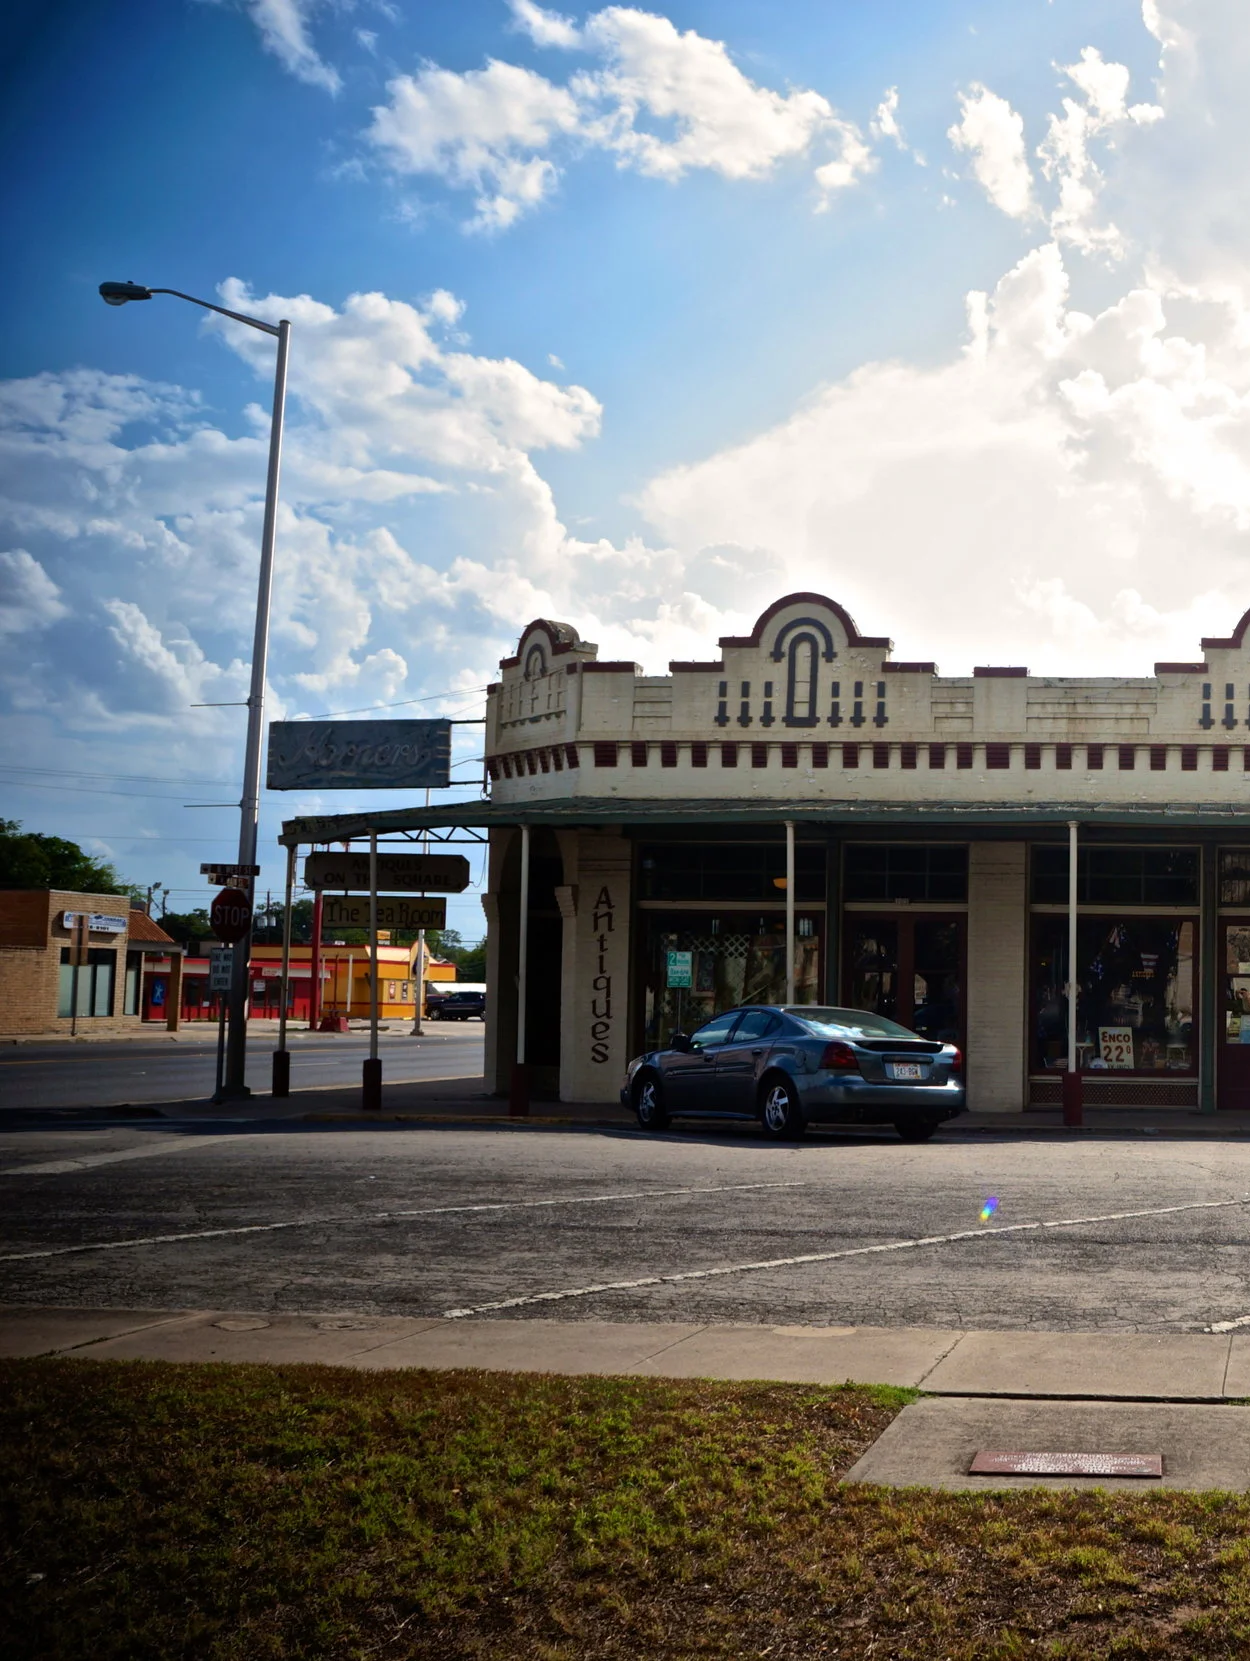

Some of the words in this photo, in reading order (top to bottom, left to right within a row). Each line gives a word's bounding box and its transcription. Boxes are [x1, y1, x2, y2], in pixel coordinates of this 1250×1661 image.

[351, 858, 423, 873] ANIQUES
[324, 872, 345, 884] ON
[214, 904, 250, 928] STOP
[325, 898, 360, 923] The
[398, 902, 445, 927] Room
[669, 953, 676, 965] 2
[591, 885, 616, 1065] Antiques
[1101, 1031, 1131, 1043] ENCO
